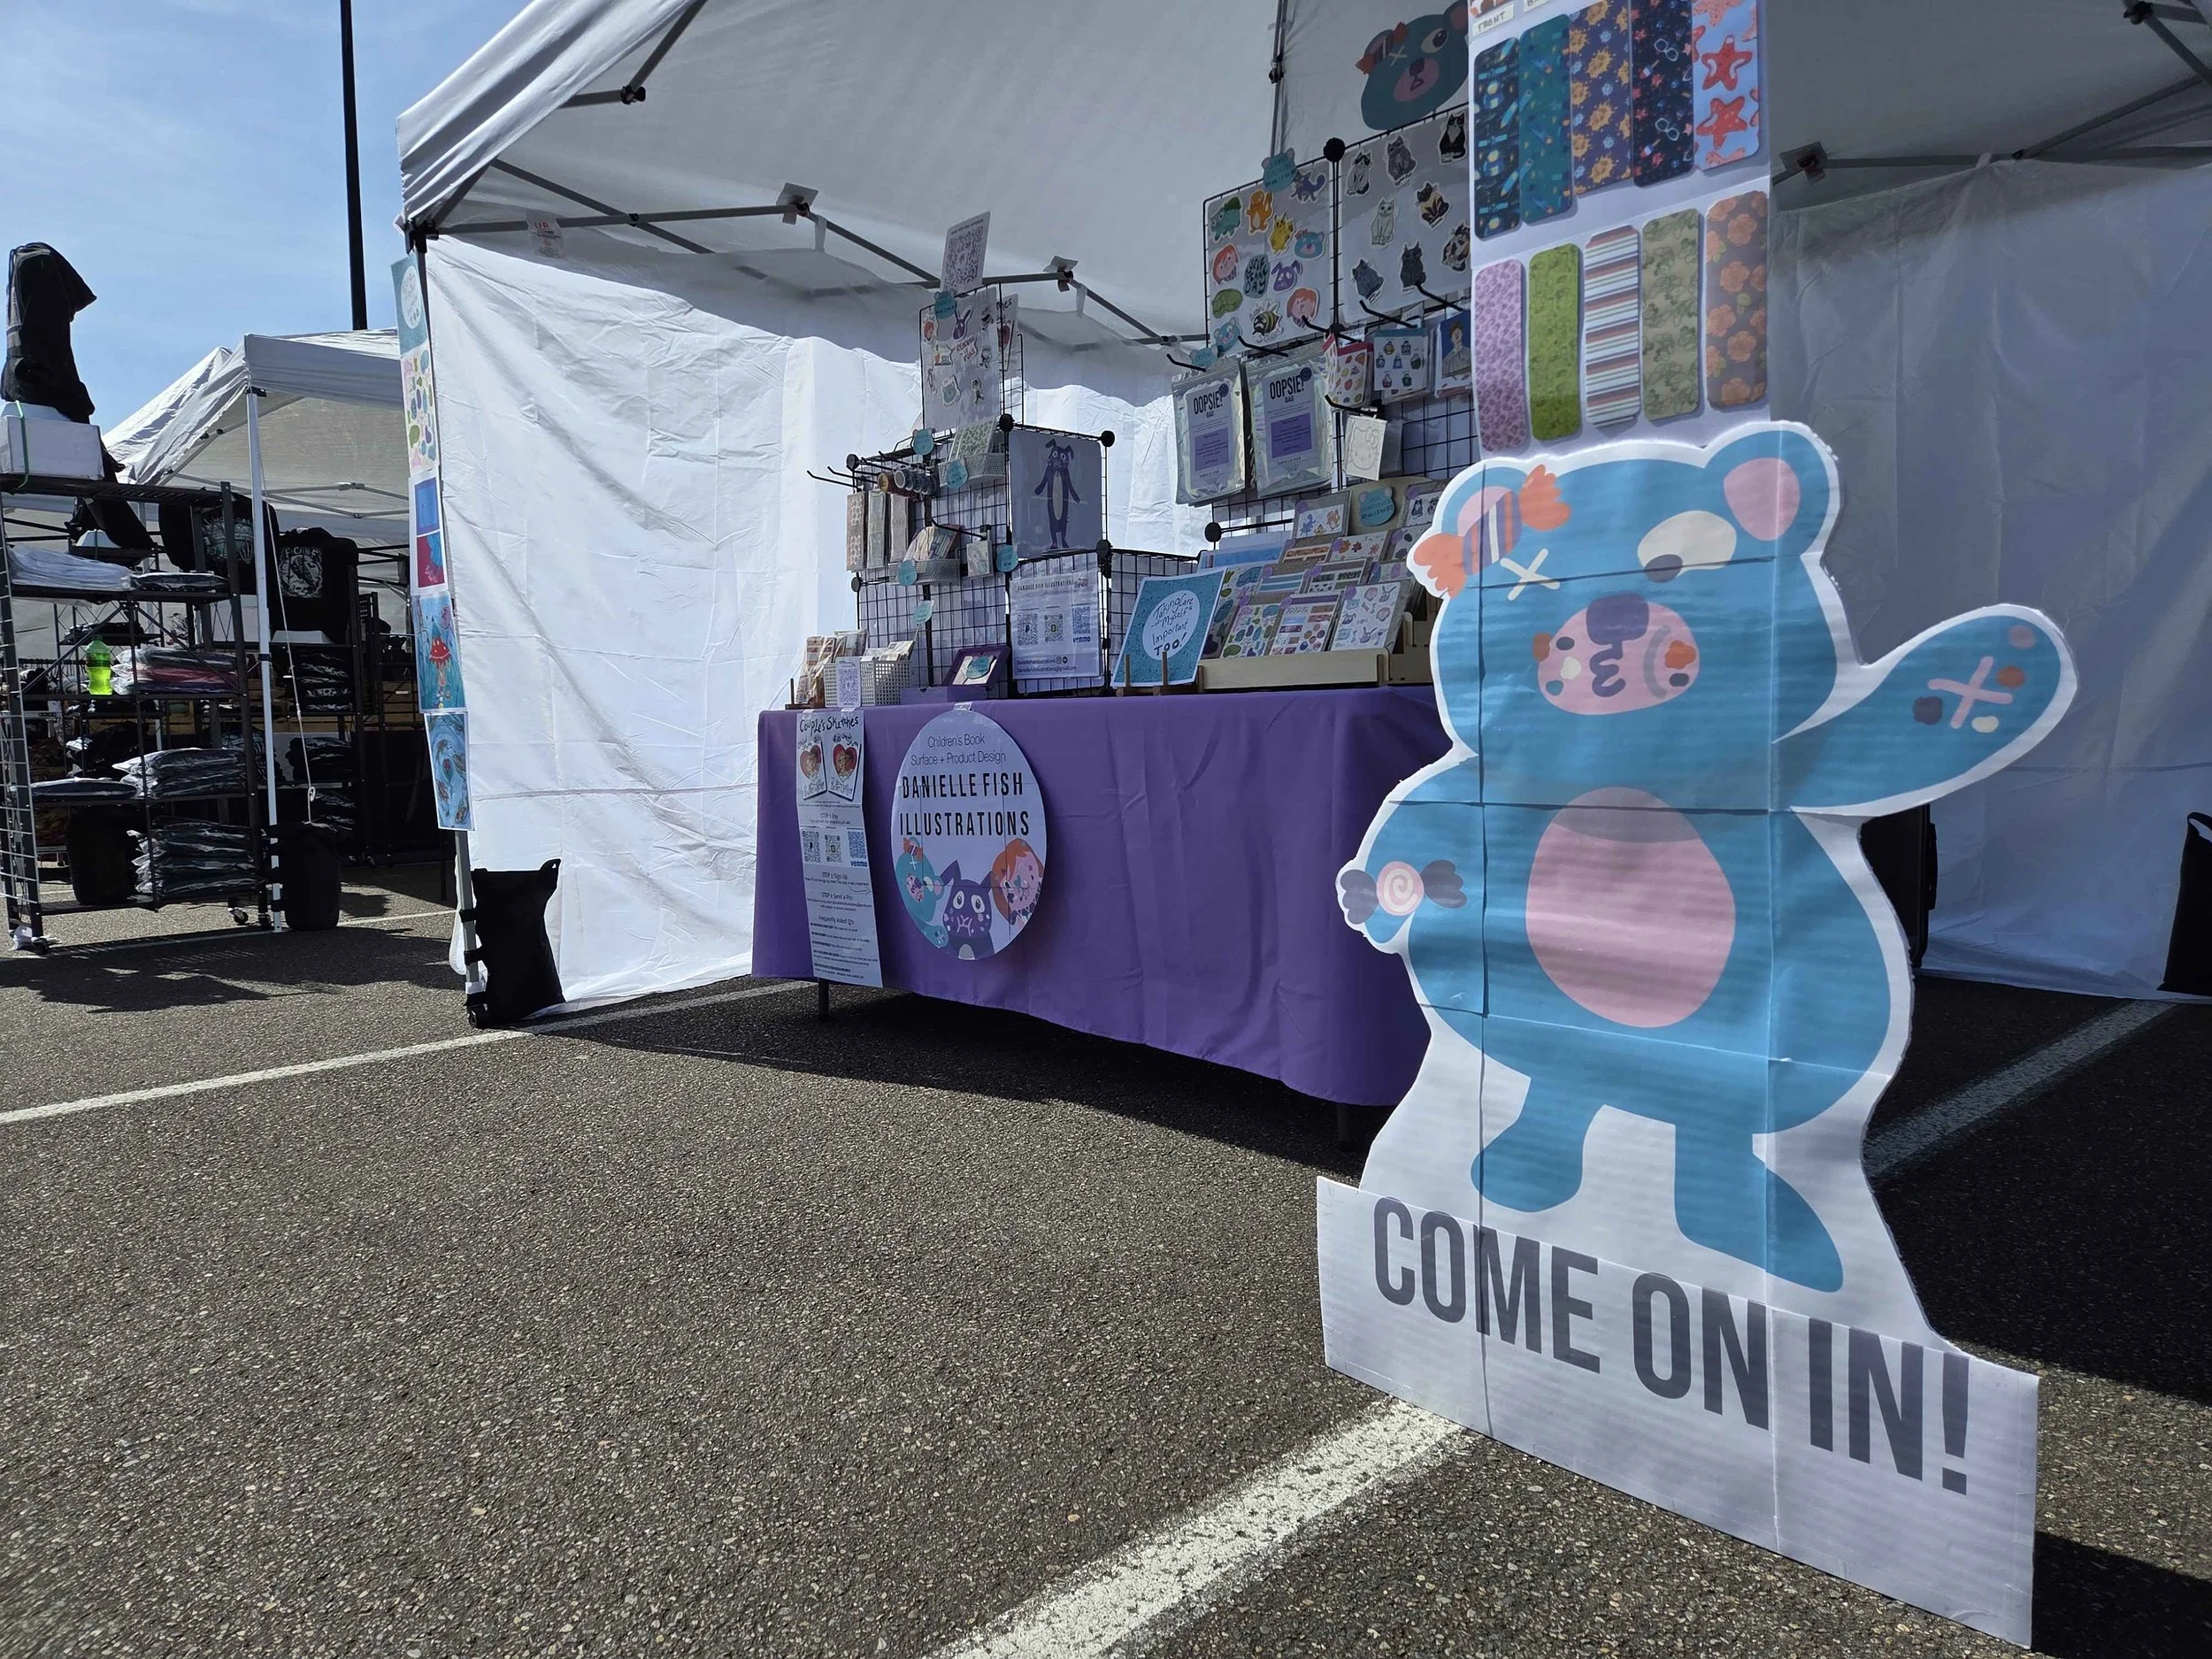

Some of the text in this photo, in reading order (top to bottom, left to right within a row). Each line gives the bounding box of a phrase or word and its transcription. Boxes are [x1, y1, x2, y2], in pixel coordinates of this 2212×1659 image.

[1478, 11, 1505, 32] FRONT
[1270, 374, 1305, 400] OOPSIE!
[1285, 396, 1294, 404] BAG
[1194, 389, 1224, 415] OOPSIE!
[1152, 618, 1188, 645] Important
[1154, 632, 1187, 656] TOO!
[927, 733, 986, 749] Children's Book
[910, 754, 938, 766] Surface
[947, 752, 976, 764] Product
[978, 749, 1006, 764] Design
[902, 772, 1023, 799] DANIELLE FISH
[900, 810, 1029, 836] ILLUSTRATIONS
[1372, 1195, 1970, 1496] COME ON IN!
